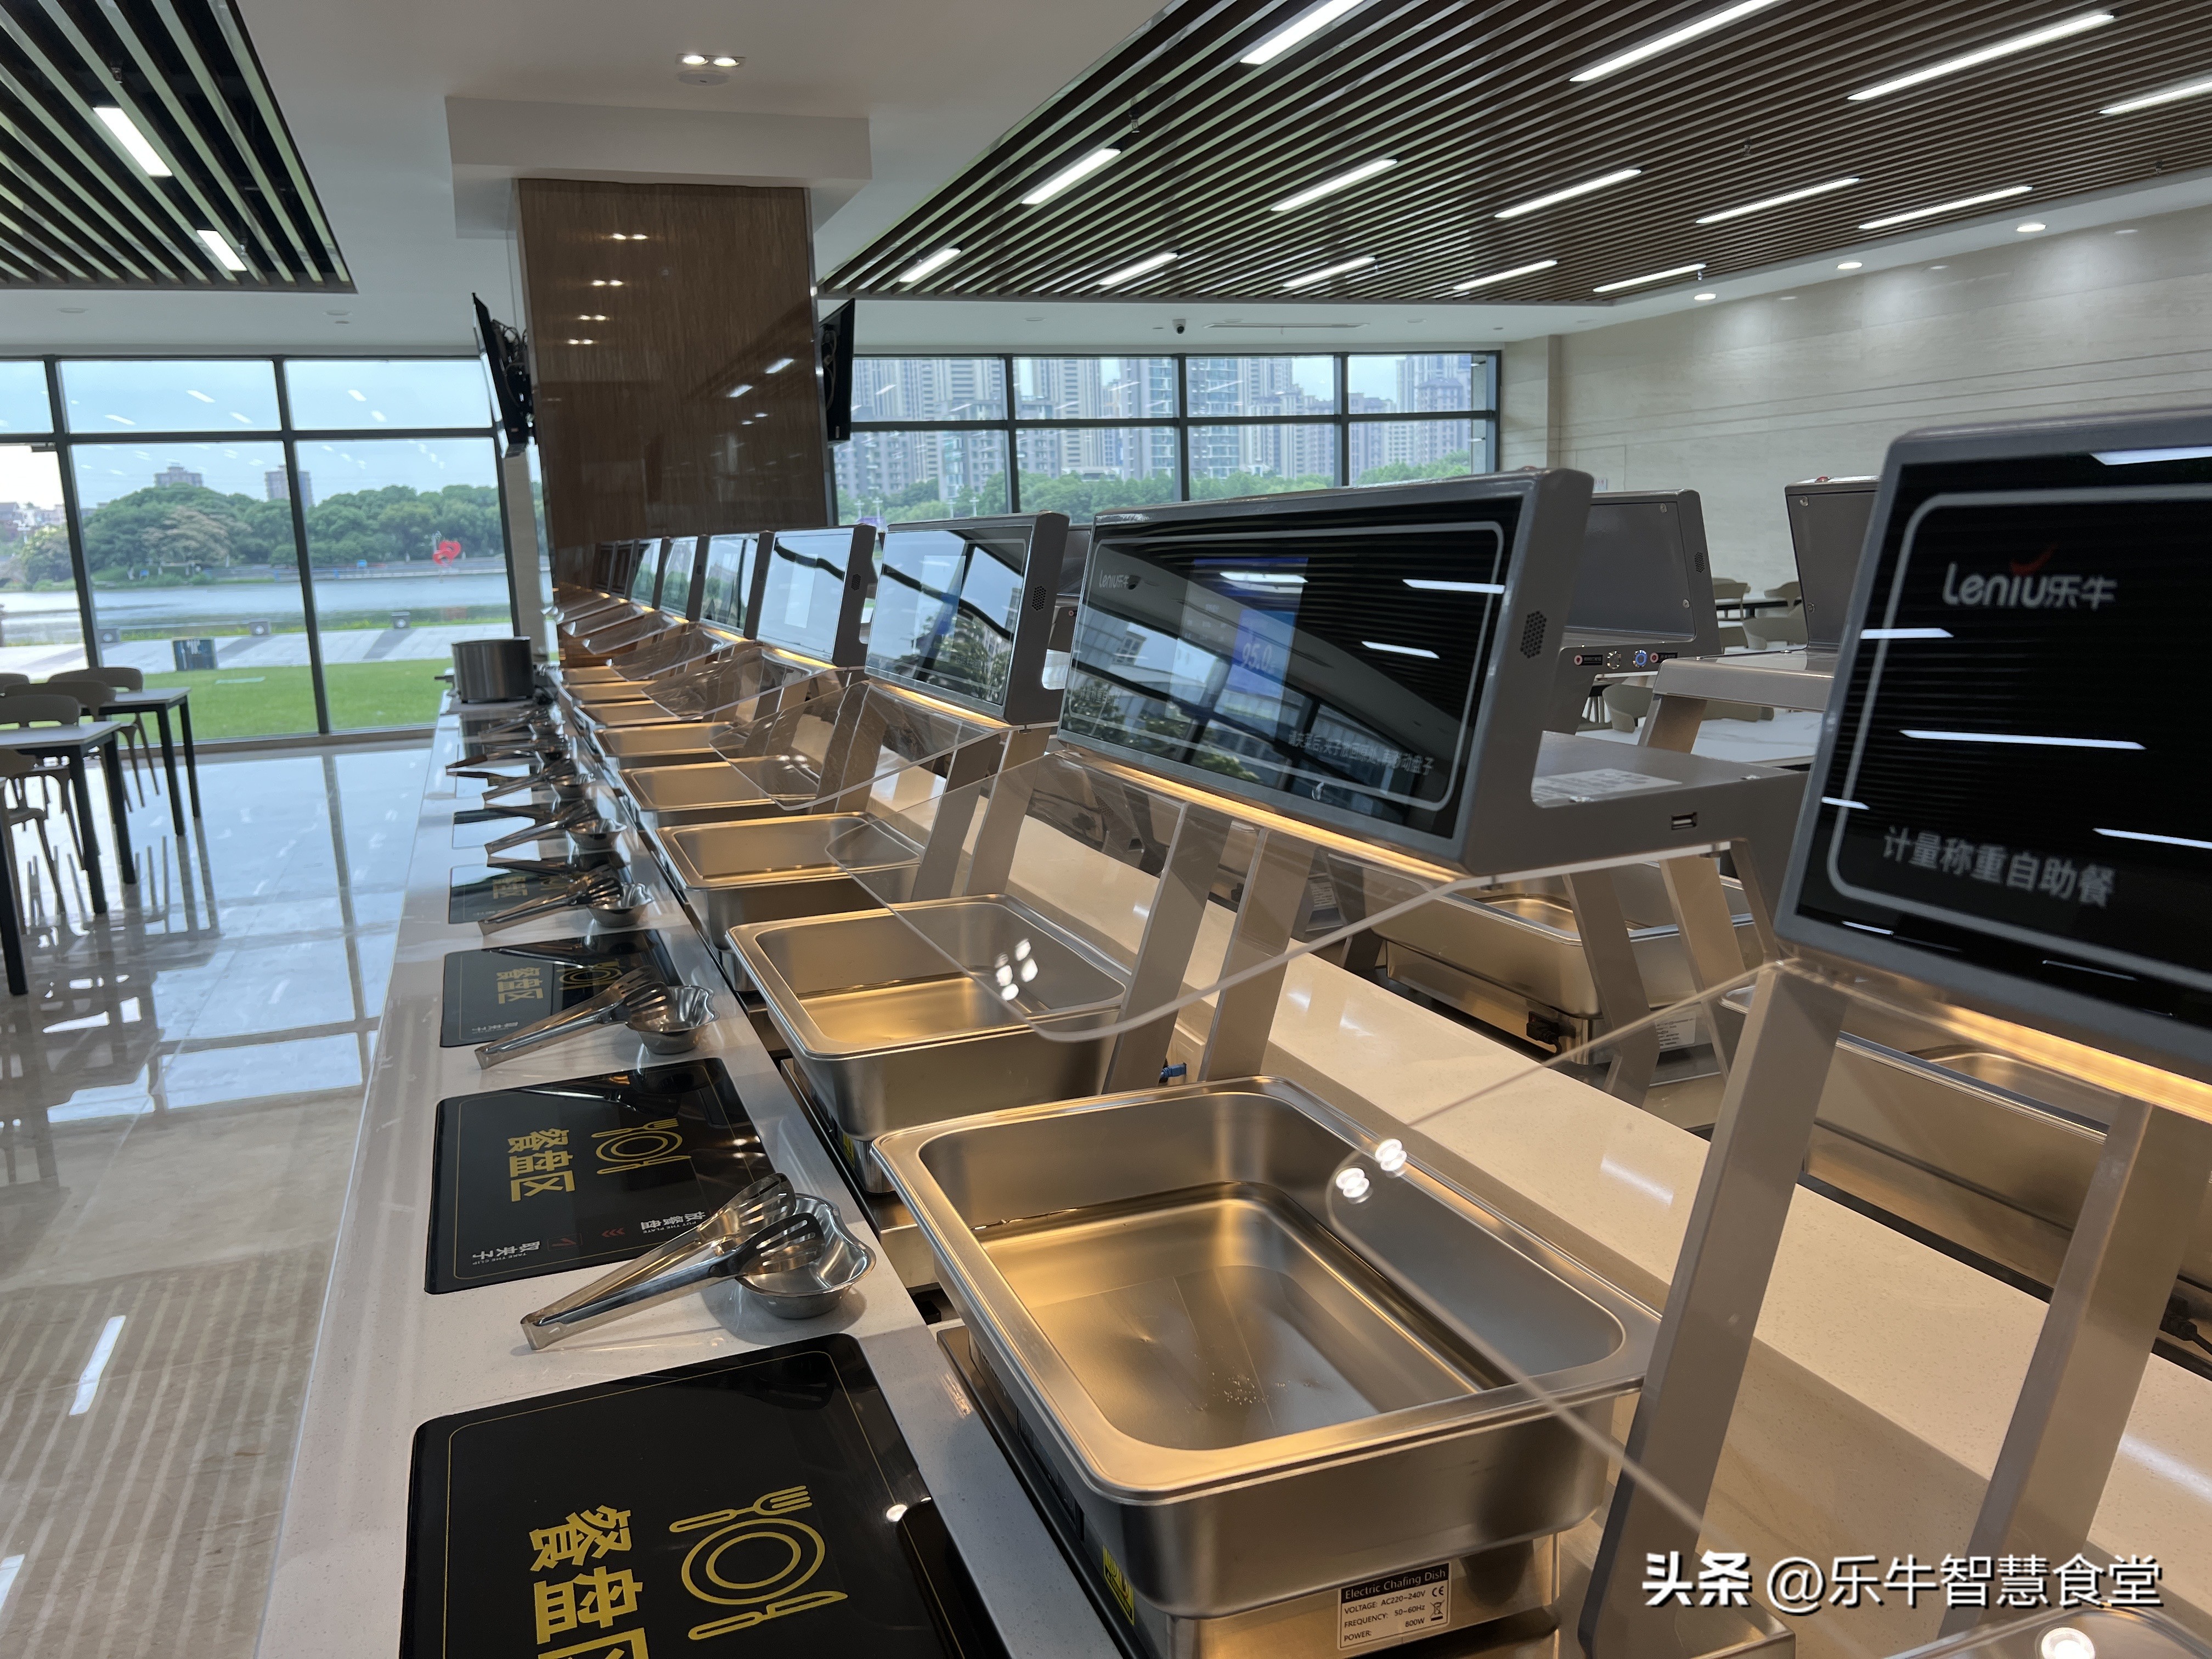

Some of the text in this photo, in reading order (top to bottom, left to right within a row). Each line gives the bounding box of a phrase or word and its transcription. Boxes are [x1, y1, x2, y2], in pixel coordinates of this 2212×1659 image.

[1882, 825, 2116, 909] 计量称重自助餐
[507, 1127, 577, 1201] 餐盘区
[640, 1211, 706, 1230] 放餐盘
[472, 1241, 540, 1260] 取夹子
[1345, 1568, 1446, 1599] Electric Chafing Dish
[1344, 1600, 1378, 1614] VOLTAGE:
[1344, 1612, 1389, 1628] FREQUENCY:
[1344, 1617, 1425, 1641] POWER: 800W
